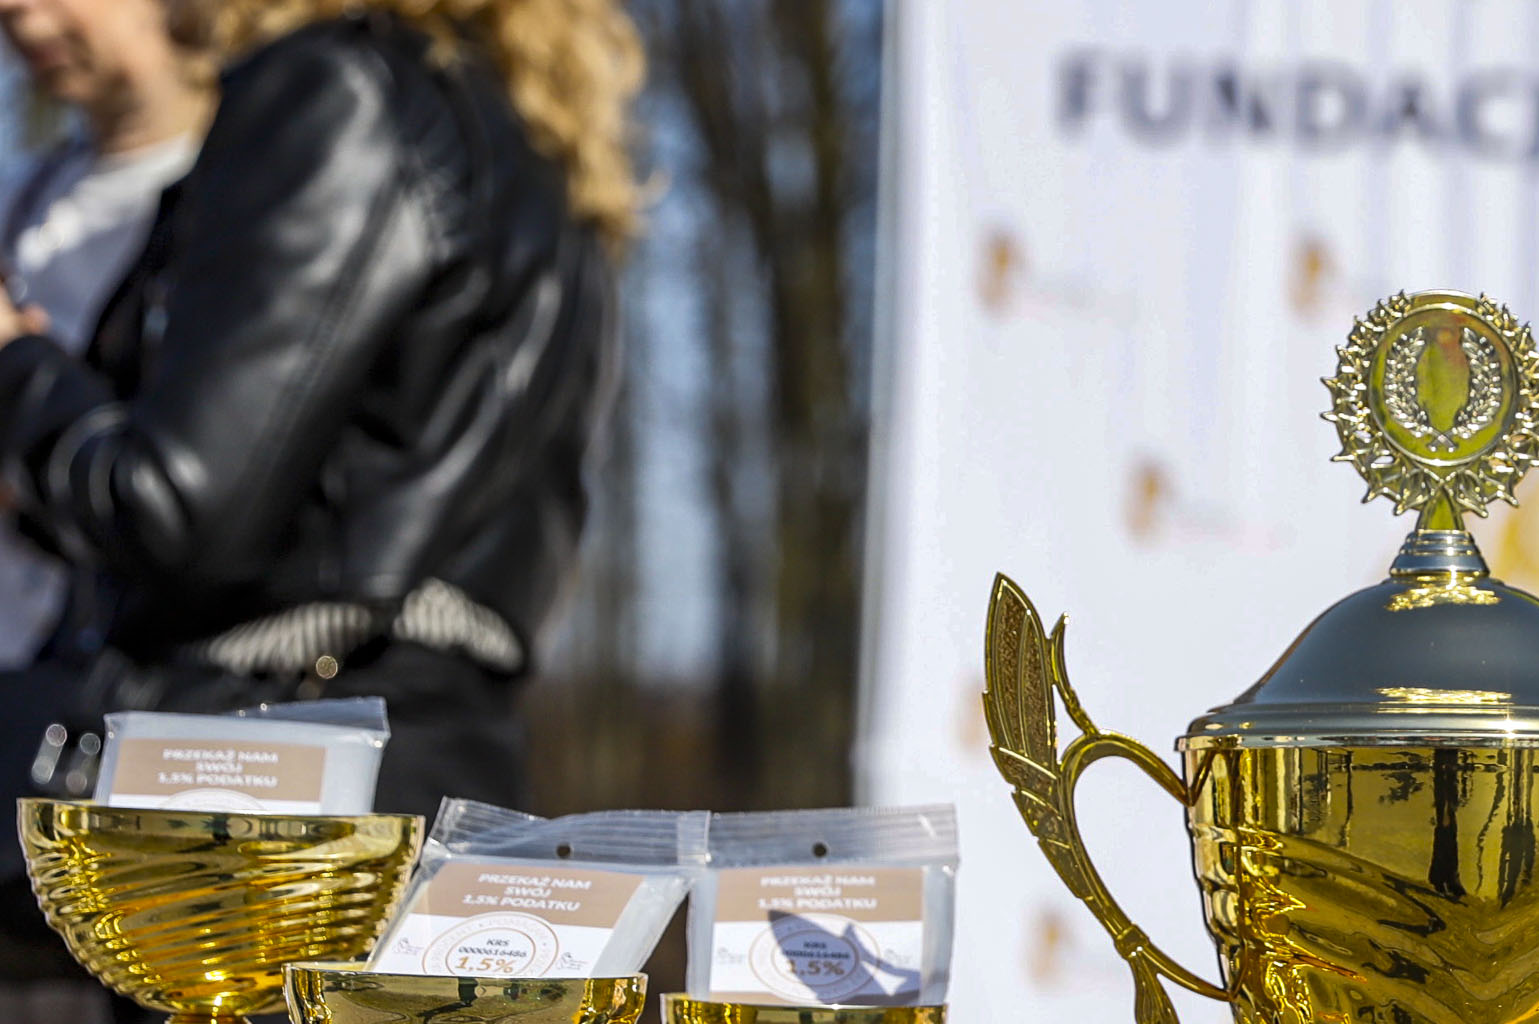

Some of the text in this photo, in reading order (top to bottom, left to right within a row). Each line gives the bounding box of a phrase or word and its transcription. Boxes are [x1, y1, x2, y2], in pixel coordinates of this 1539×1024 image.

[478, 873, 591, 889] PRZEKAŻ NAM
[504, 884, 552, 897] SWÓJ
[499, 897, 580, 911] PODATKU
[455, 956, 516, 973] 1,5%
